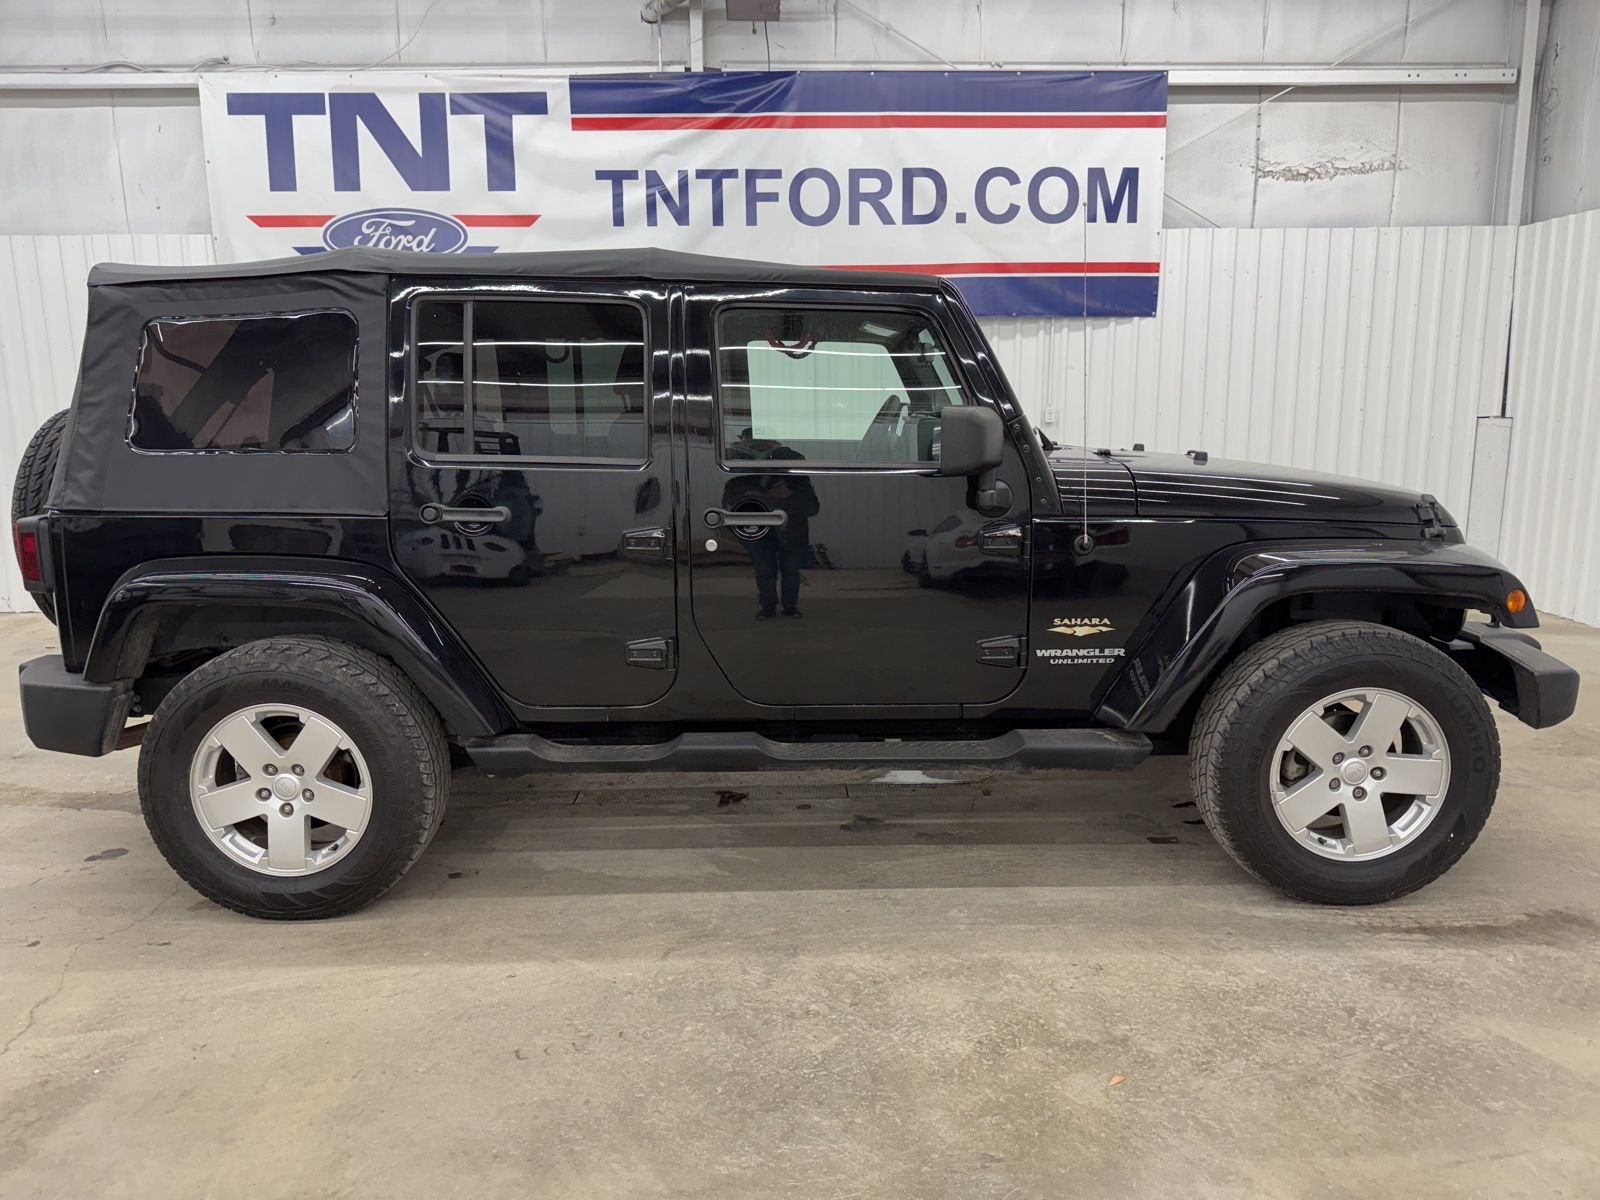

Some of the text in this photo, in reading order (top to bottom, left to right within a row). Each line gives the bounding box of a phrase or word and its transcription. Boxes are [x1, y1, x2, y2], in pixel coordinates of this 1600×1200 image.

[226, 91, 549, 192] TNT
[595, 166, 1139, 227] TNTFORD.COM
[353, 217, 437, 253] Ford
[1053, 617, 1111, 625] SAHARA
[1035, 648, 1126, 657] WRANGLER
